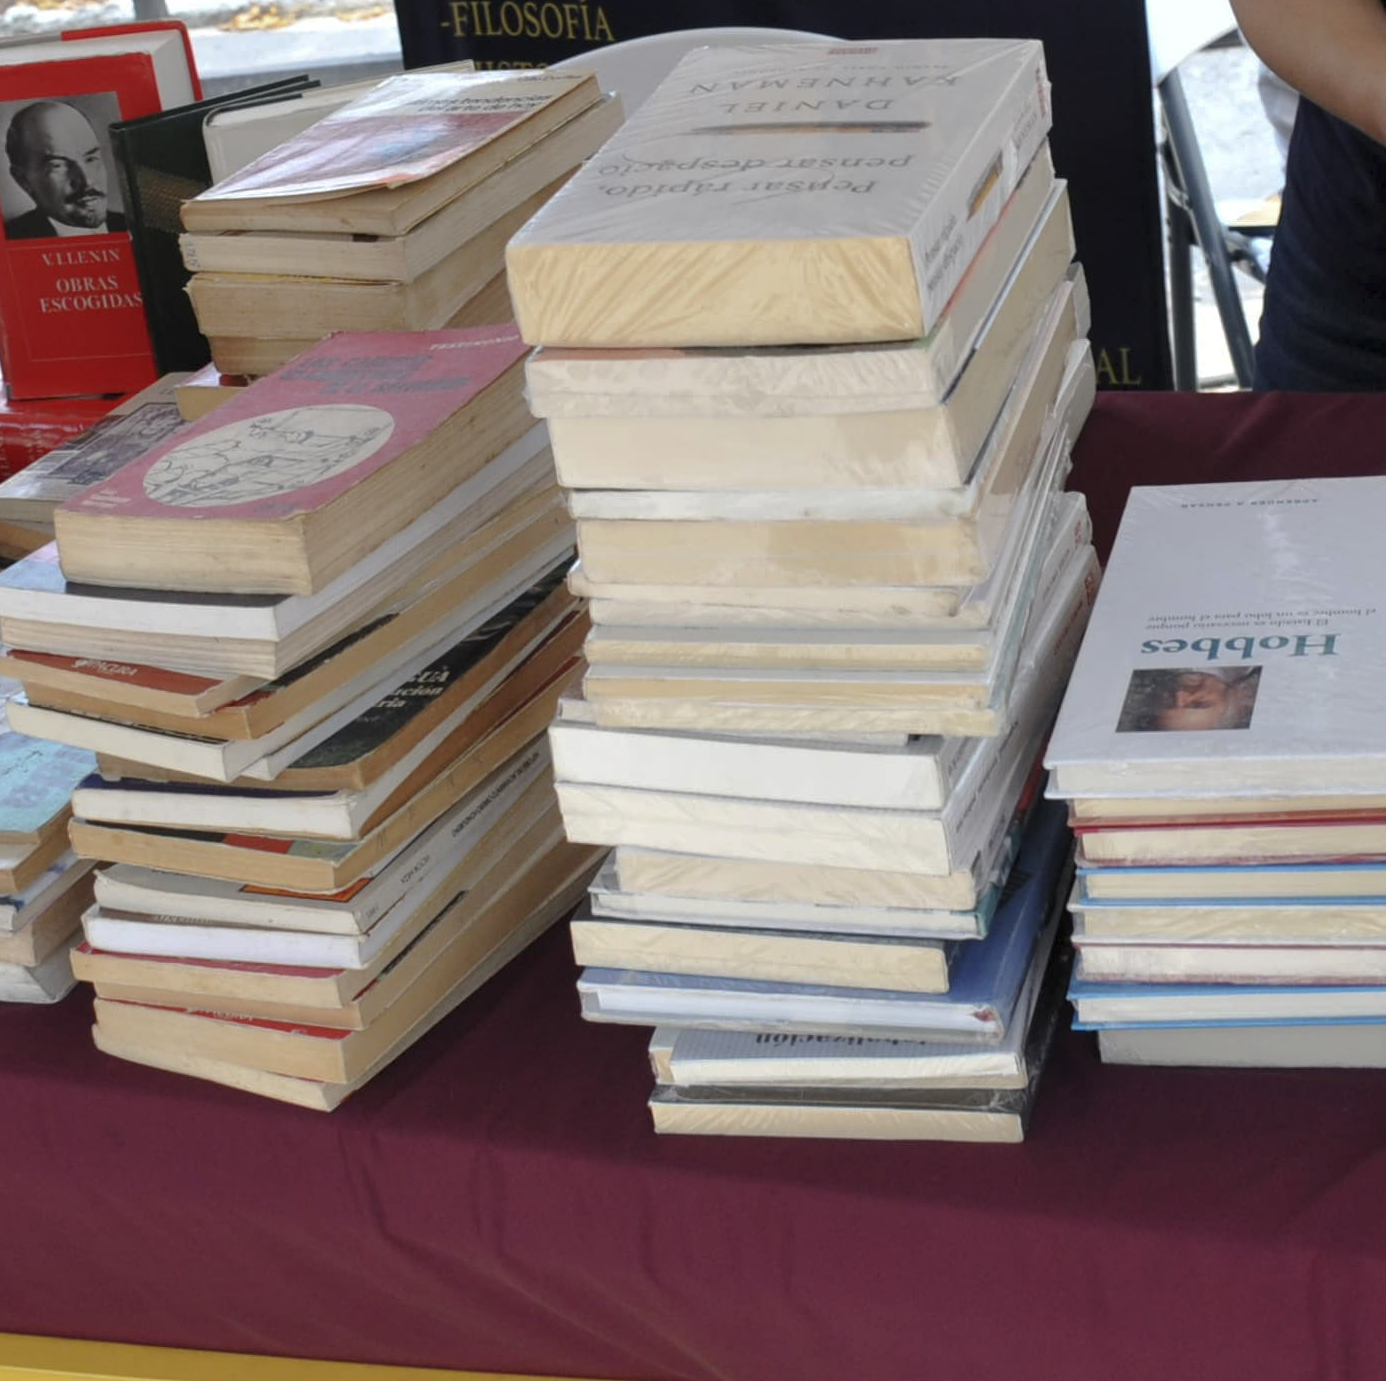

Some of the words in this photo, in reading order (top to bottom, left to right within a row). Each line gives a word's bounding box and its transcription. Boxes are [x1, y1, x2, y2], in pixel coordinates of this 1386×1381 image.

[689, 76, 957, 93] KAHNEMAN
[715, 99, 893, 114] DANIEL
[598, 159, 764, 178] despacio
[771, 155, 913, 172] pensar
[742, 179, 875, 195] Pensar
[56, 275, 118, 293] OBRAS
[39, 292, 143, 313] ESCOGIDAS
[1141, 633, 1341, 661] Hobbes
